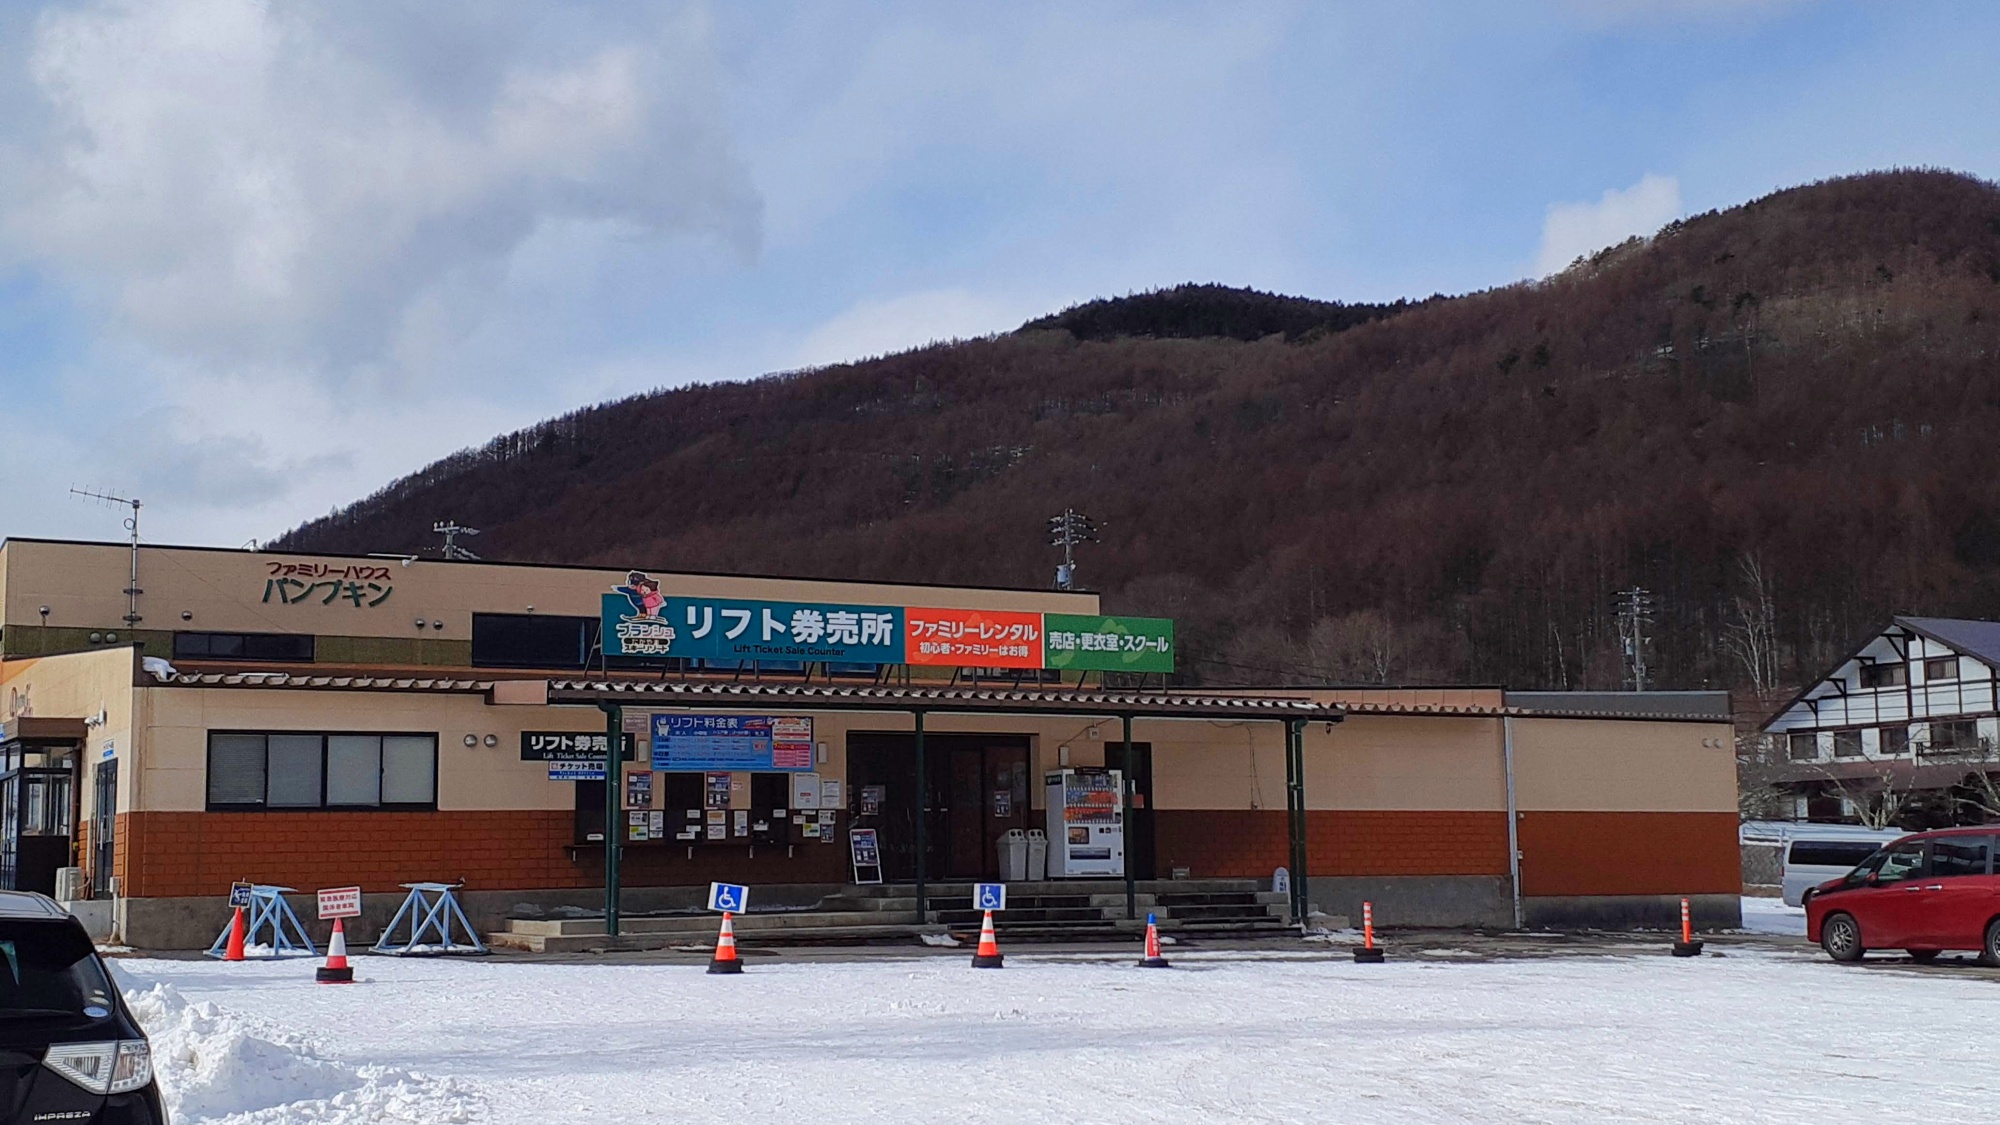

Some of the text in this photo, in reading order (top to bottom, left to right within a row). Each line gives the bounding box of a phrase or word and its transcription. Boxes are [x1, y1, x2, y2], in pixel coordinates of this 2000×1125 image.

[266, 562, 391, 580] ファミリーハウス
[262, 577, 393, 607] パンプキン
[617, 624, 675, 638] ブランシュ
[686, 606, 893, 646] リフト券売所
[910, 620, 1038, 642] ファミリーレンタル
[734, 644, 845, 656] Lift Ticket Sale Counter
[920, 642, 1029, 657] 初心者・ファミリーはお得
[1049, 631, 1169, 653] 売店・更衣室・スクール
[671, 717, 738, 728] リフト料金表
[34, 1111, 91, 1121] IMPREZA
